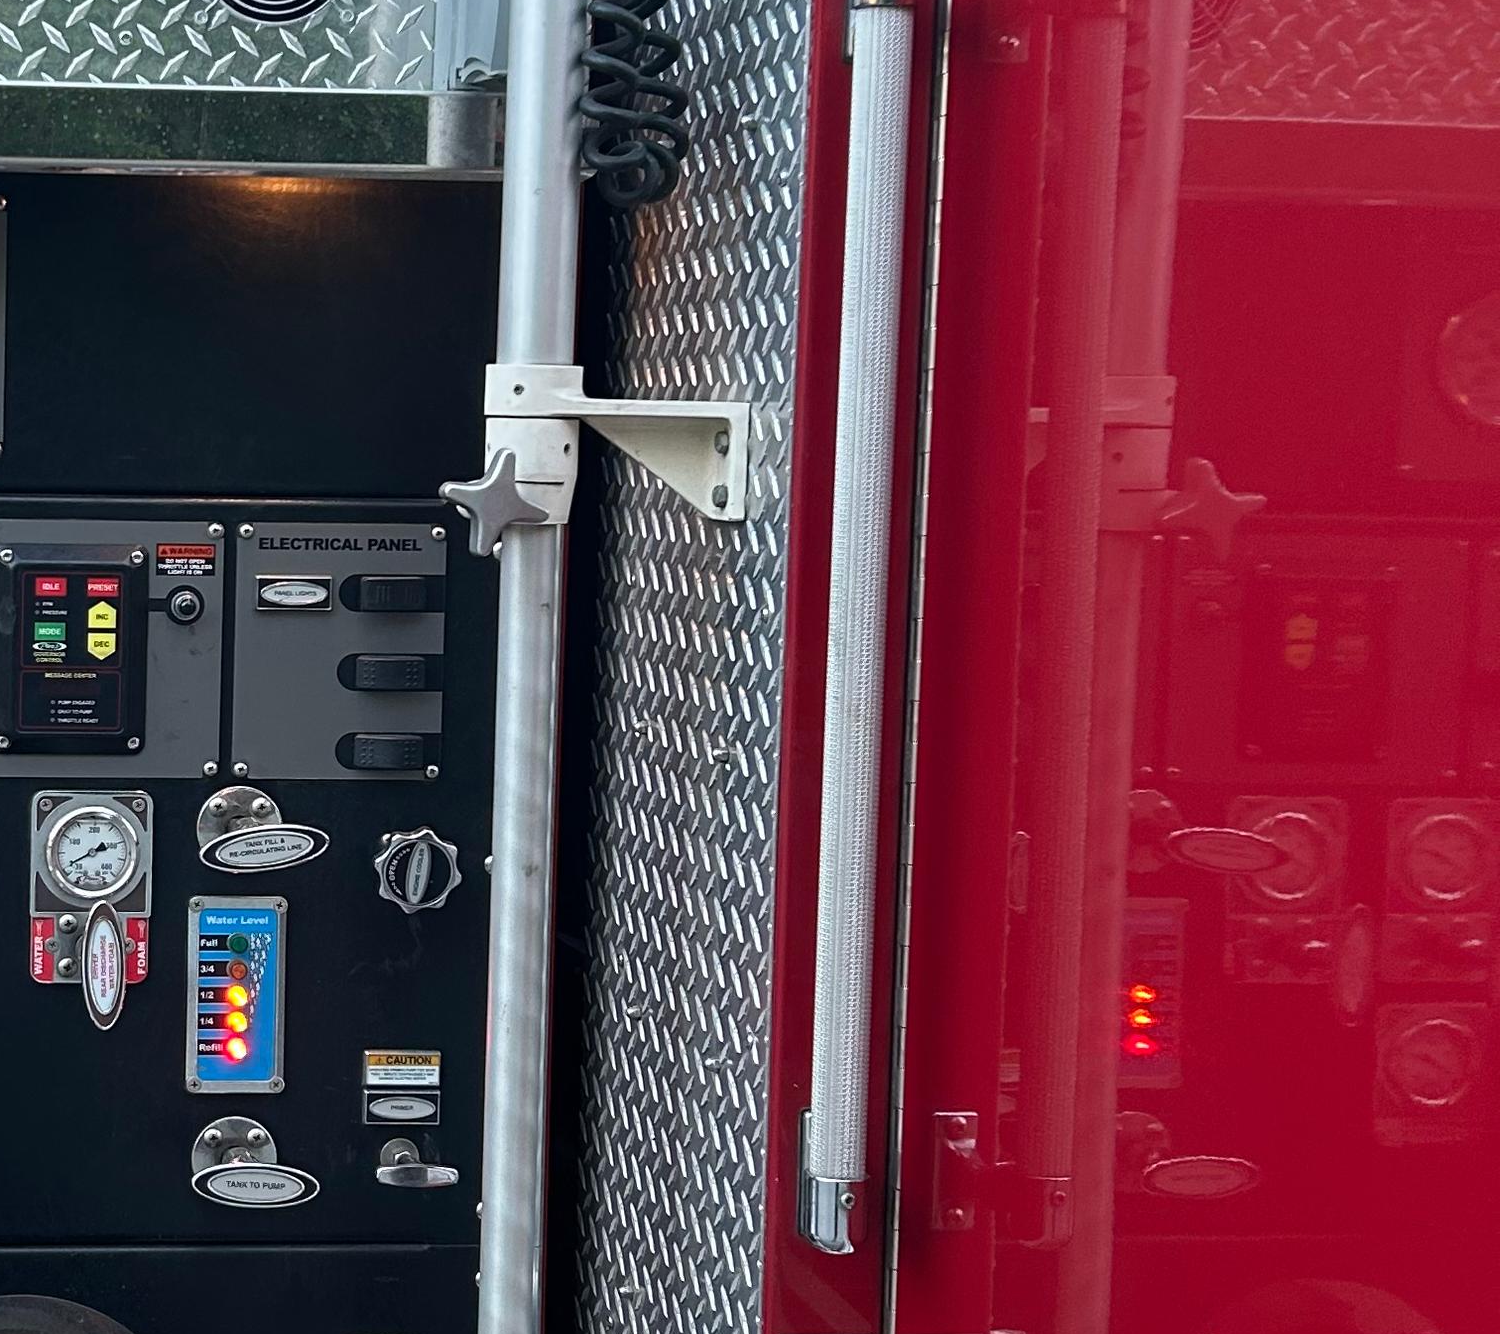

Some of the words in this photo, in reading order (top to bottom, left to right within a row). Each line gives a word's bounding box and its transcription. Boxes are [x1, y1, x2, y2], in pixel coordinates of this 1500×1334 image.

[258, 537, 363, 551] ELECTRICAL
[367, 538, 422, 552] PANEL
[87, 583, 118, 591] PRESET
[244, 840, 263, 848] TANK
[229, 846, 286, 858] RE-CIRCULATING
[388, 859, 398, 881] OPEN
[206, 915, 238, 925] Water
[240, 916, 269, 925] Level
[200, 938, 218, 947] Full
[33, 935, 44, 975] WATER
[137, 941, 147, 975] FOAM
[200, 964, 215, 973] 3/4
[200, 990, 215, 999] 1/2
[200, 1016, 214, 1025] 1/4
[199, 1043, 224, 1052] Refill
[386, 1056, 432, 1065] CAUTION
[225, 1180, 248, 1188] TANK
[262, 1181, 286, 1189] PUMP
